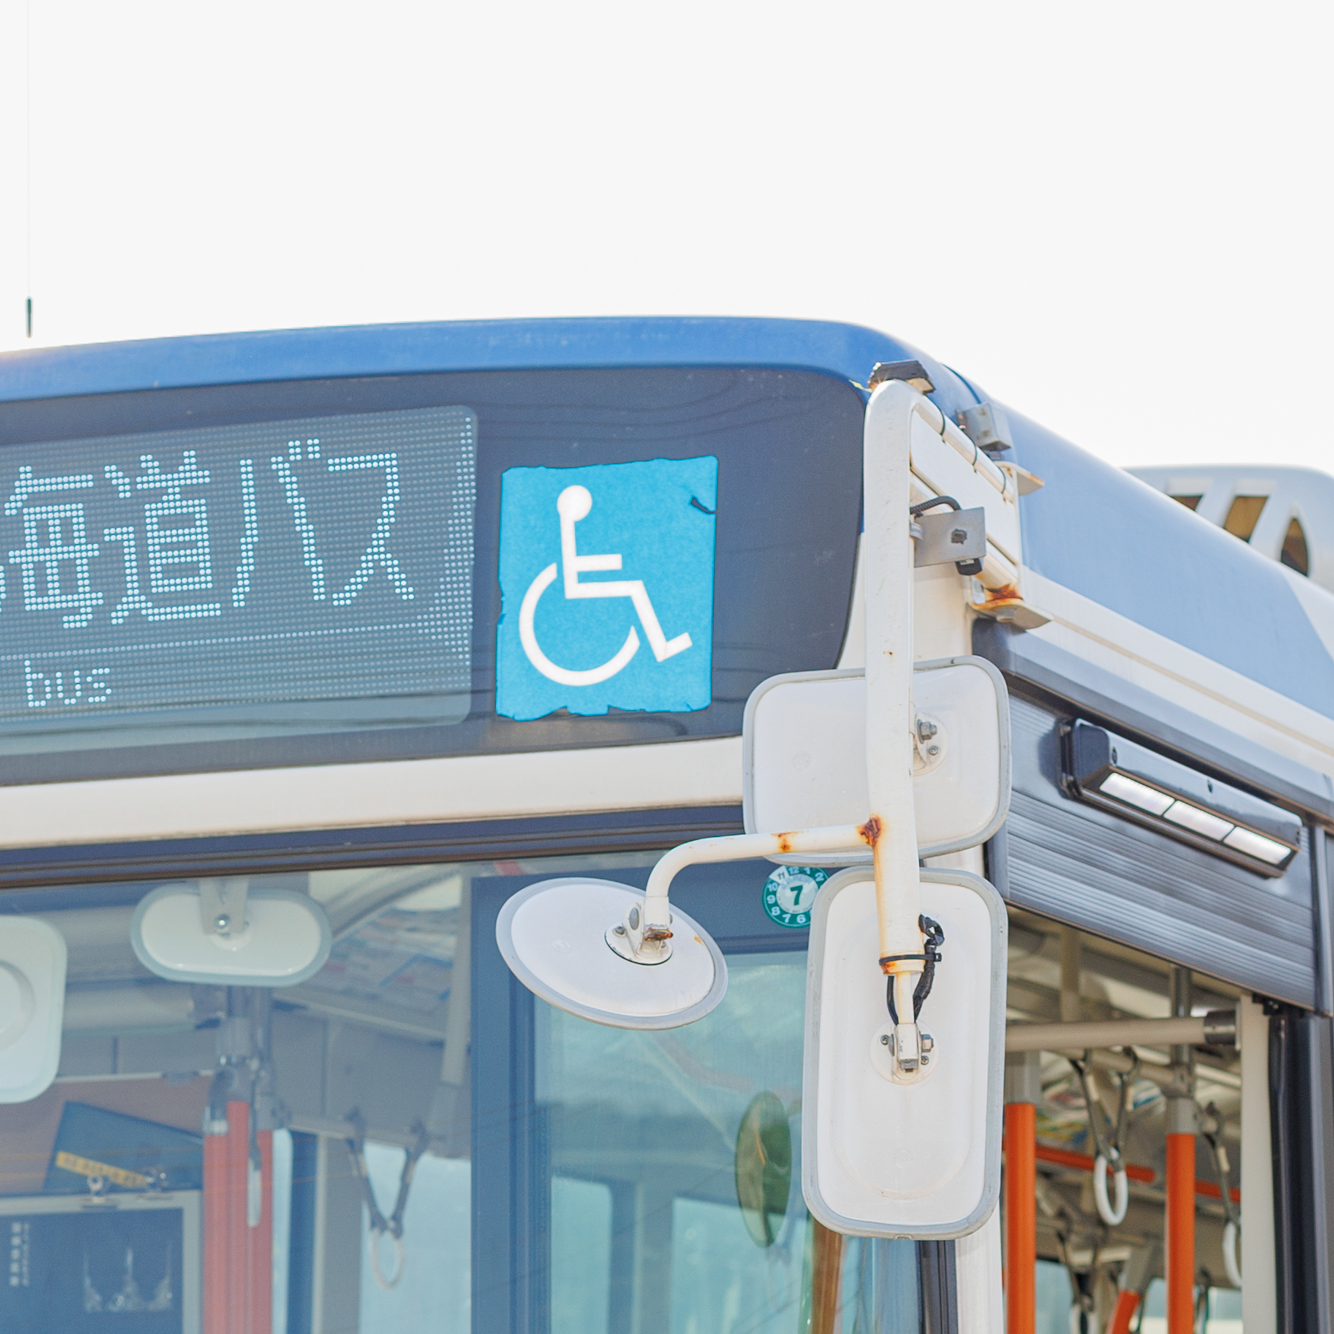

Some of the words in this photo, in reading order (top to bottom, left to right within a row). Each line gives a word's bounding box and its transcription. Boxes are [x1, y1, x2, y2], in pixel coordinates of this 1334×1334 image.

[23, 660, 113, 707] bus
[815, 872, 825, 882] 2
[767, 882, 778, 892] 10
[766, 895, 776, 904] 9
[790, 885, 803, 906] 7
[771, 906, 781, 916] 8
[782, 913, 791, 923] 7
[796, 914, 806, 924] 6
